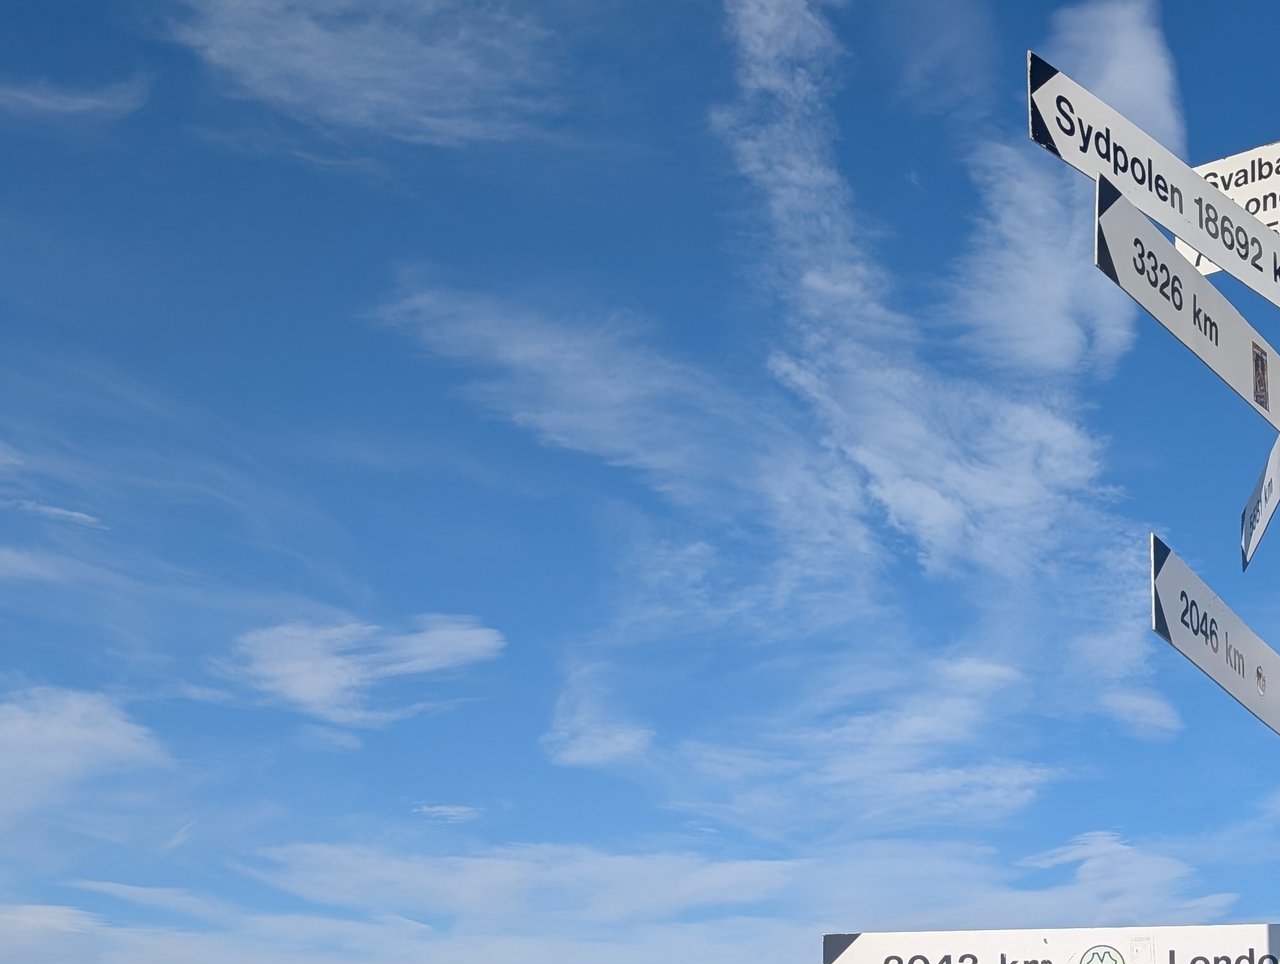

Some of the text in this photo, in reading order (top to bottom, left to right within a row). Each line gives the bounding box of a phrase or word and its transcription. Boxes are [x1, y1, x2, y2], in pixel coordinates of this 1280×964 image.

[1055, 95, 1184, 215] Sydpolen
[1194, 197, 1264, 273] 18692
[1132, 237, 1184, 311] 3326
[1193, 293, 1219, 347] km
[1180, 590, 1219, 654] 2046
[1225, 631, 1246, 679] km
